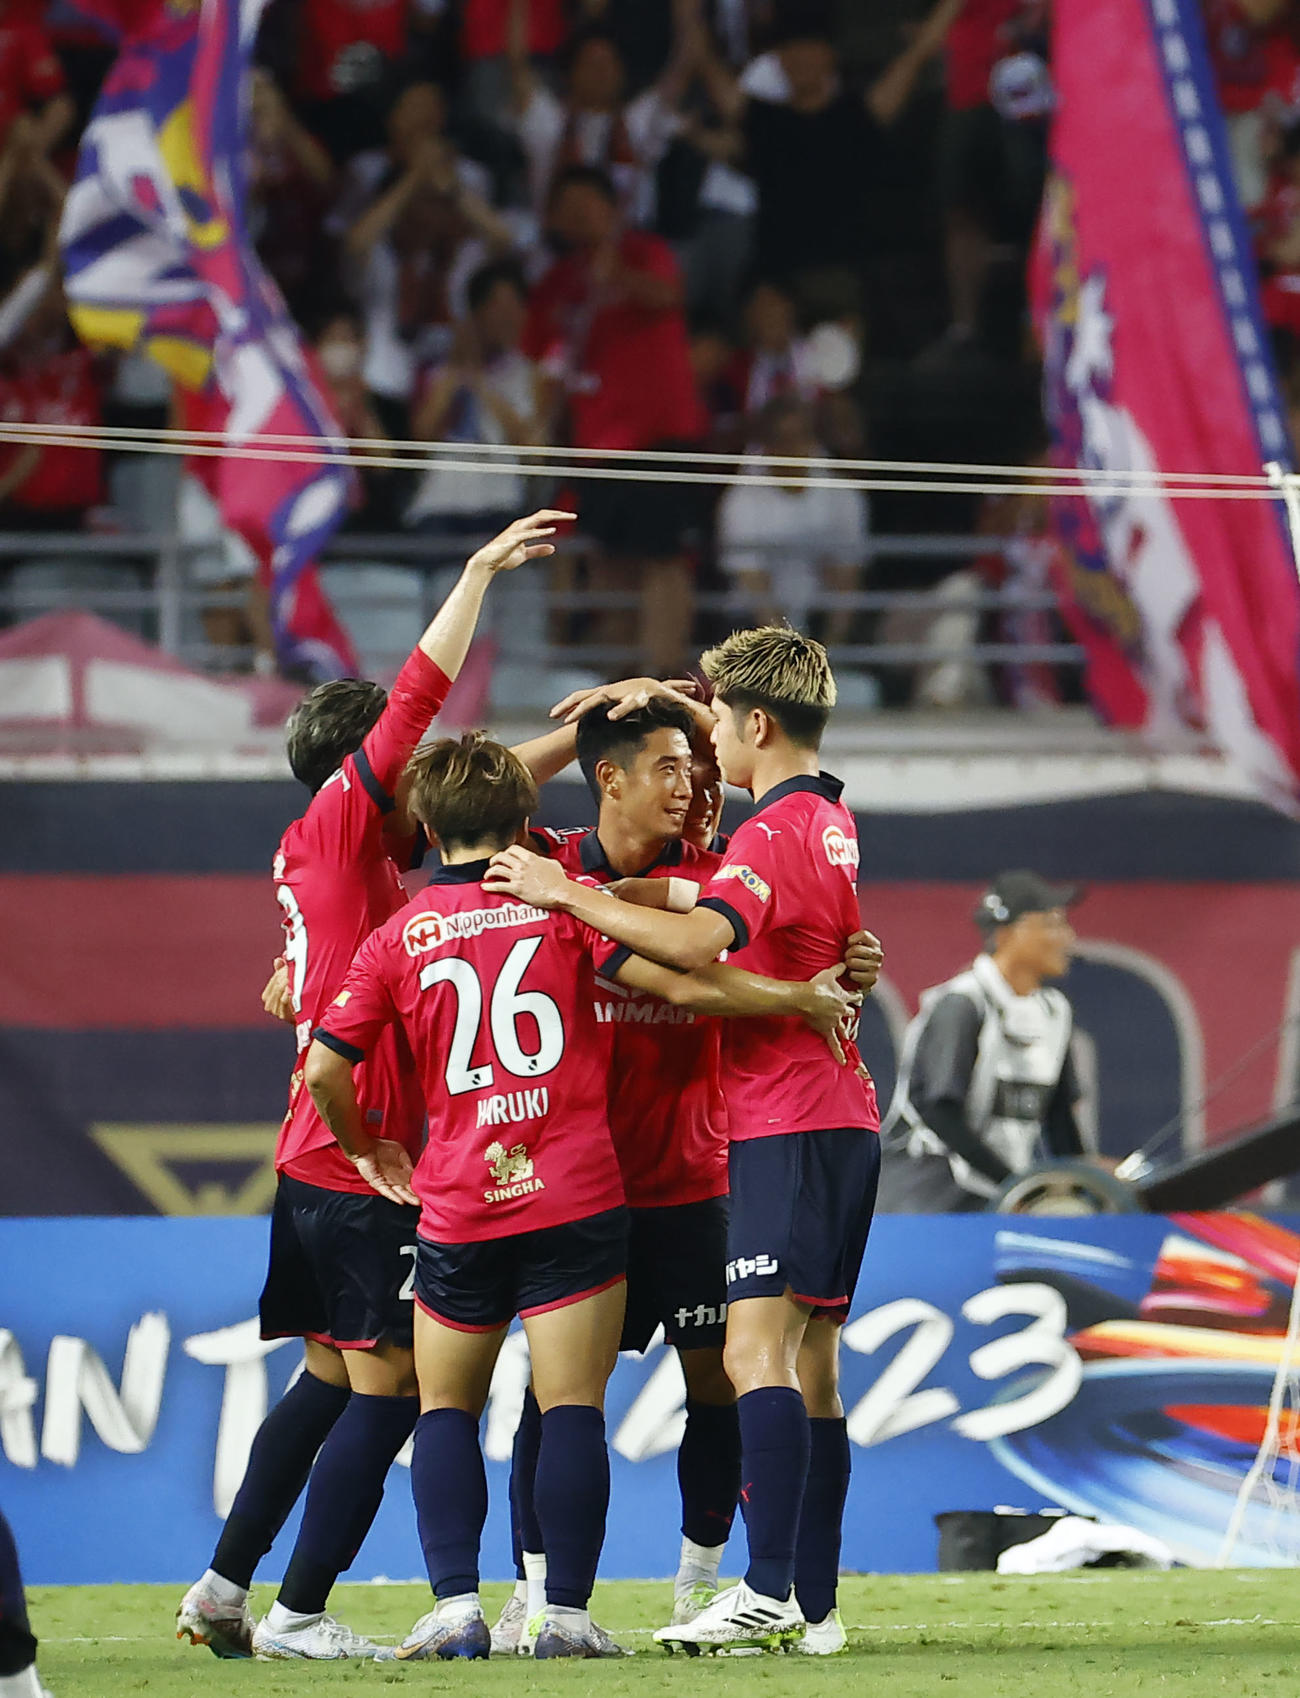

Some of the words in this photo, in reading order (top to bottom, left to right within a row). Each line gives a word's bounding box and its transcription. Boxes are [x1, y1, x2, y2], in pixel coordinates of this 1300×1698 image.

[406, 922, 442, 952] NH
[419, 934, 566, 1097] 26
[593, 1002, 695, 1024] NMAR
[483, 1178, 546, 1203] SINGHA
[398, 1244, 418, 1301] 2
